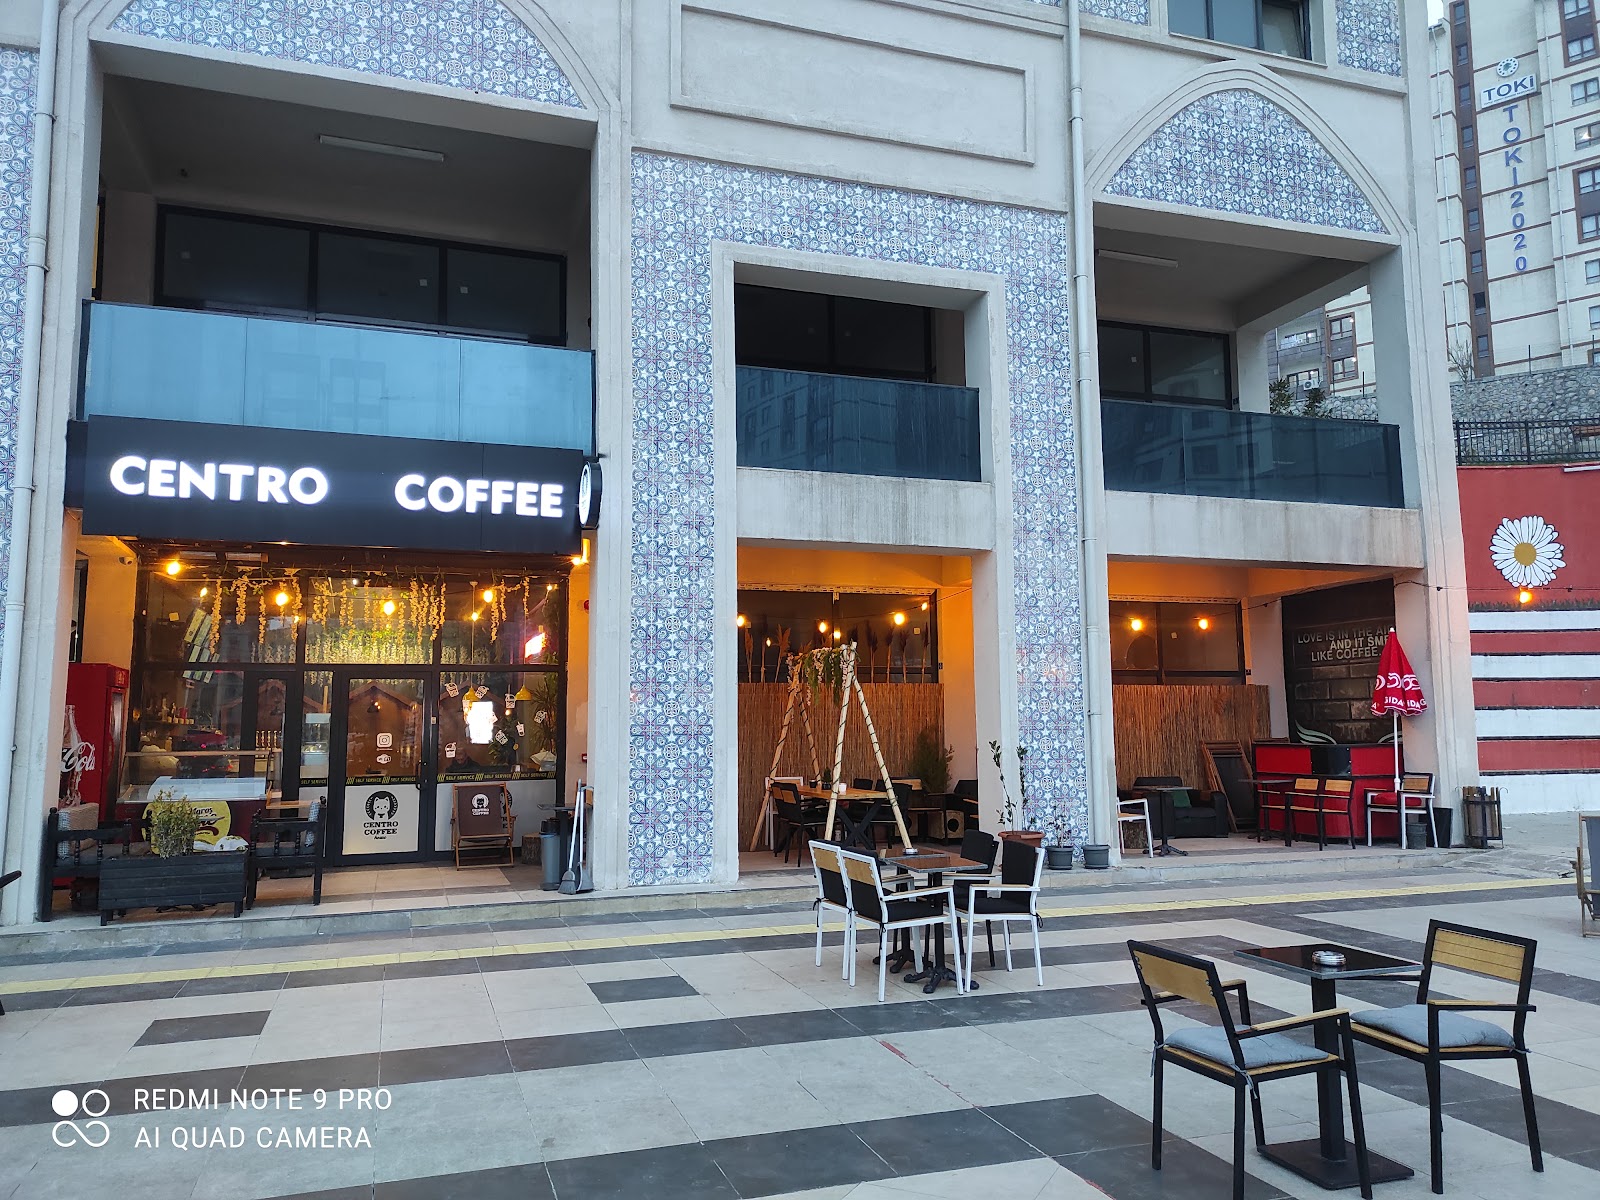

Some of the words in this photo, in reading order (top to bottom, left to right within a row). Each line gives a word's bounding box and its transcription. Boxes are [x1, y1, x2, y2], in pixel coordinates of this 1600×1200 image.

[108, 455, 330, 505] CENTRO
[394, 473, 565, 519] COFFEE
[1297, 632, 1323, 644] LOVE
[1325, 630, 1335, 641] IS
[1338, 628, 1349, 639] IN
[1352, 626, 1373, 638] THE
[1330, 638, 1352, 650] AND
[1354, 637, 1365, 648] IT
[1311, 650, 1333, 662] LIKE
[363, 820, 399, 828] CENTRO
[364, 828, 398, 836] COFFEE
